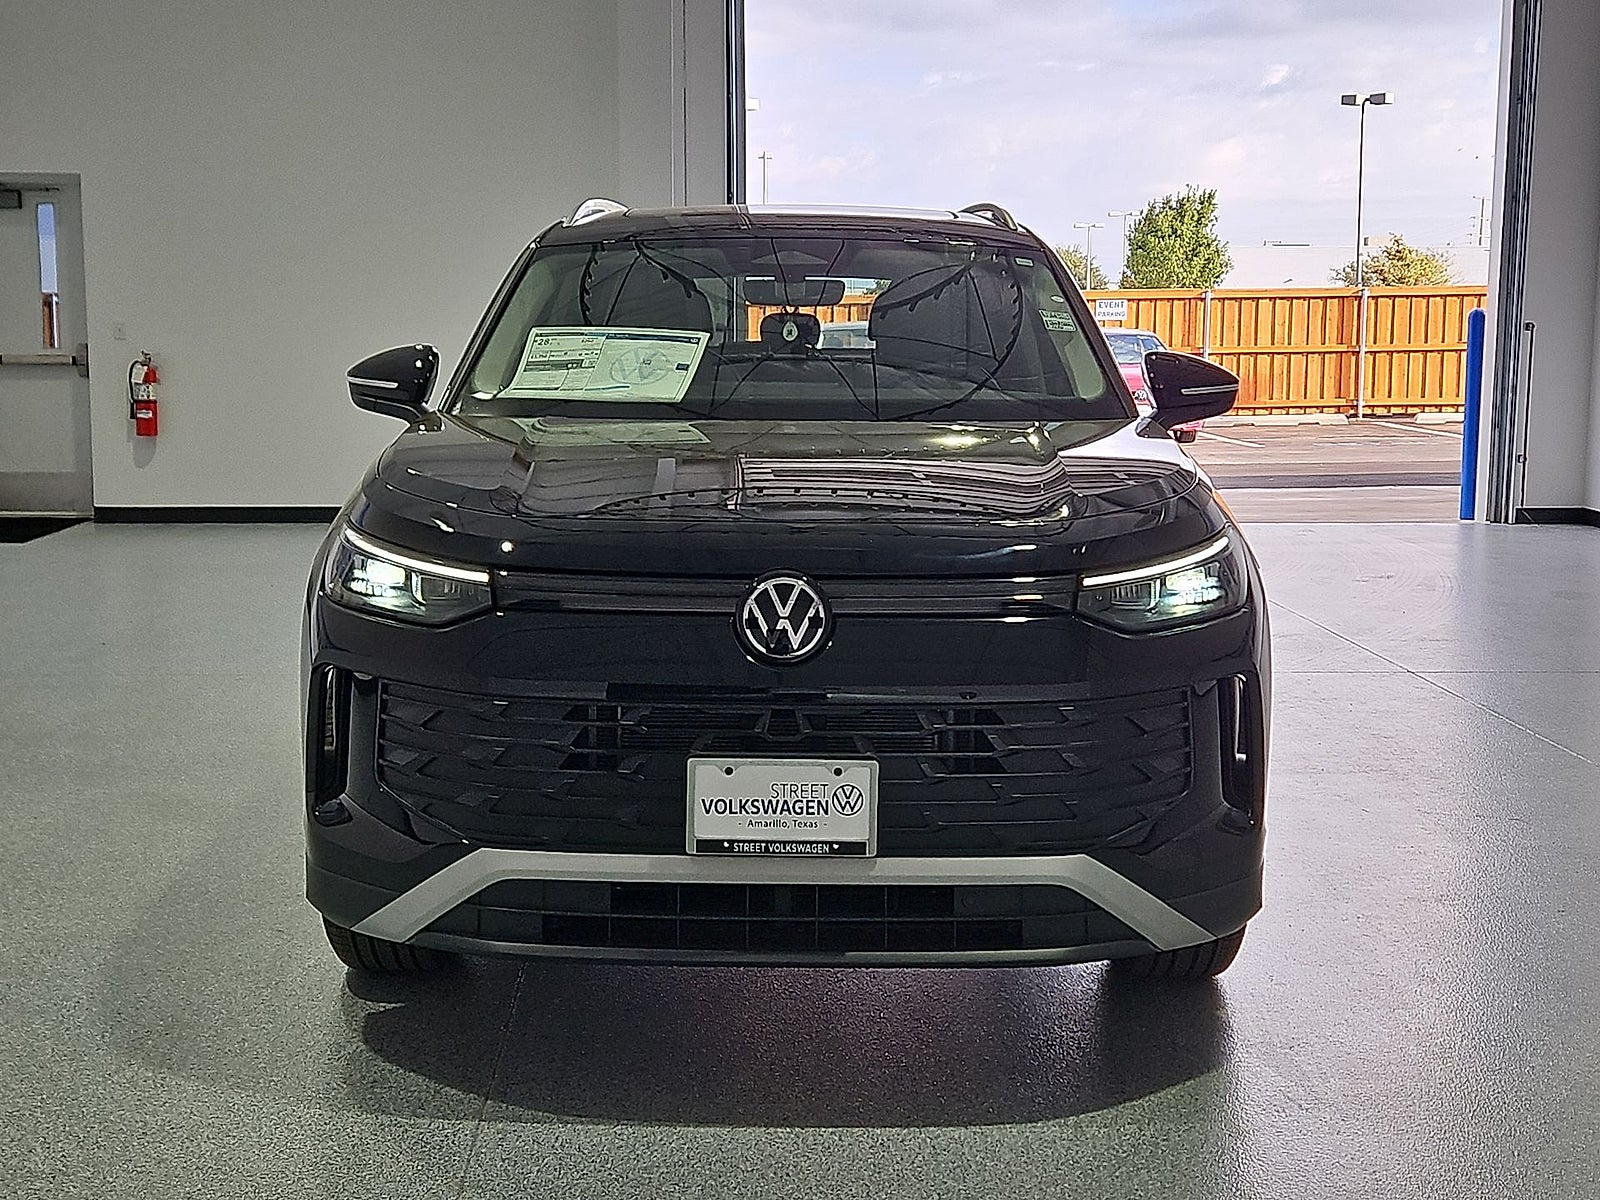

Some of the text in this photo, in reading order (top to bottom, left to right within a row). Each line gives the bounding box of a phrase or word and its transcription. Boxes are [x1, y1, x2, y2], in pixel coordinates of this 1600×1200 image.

[1098, 301, 1125, 309] EVENT
[770, 783, 829, 799] STREET
[701, 798, 829, 815] VOLKSWAGEN
[747, 819, 818, 829] Amarillo, Texas
[733, 843, 829, 853] STREET VOLKSWAGEN
